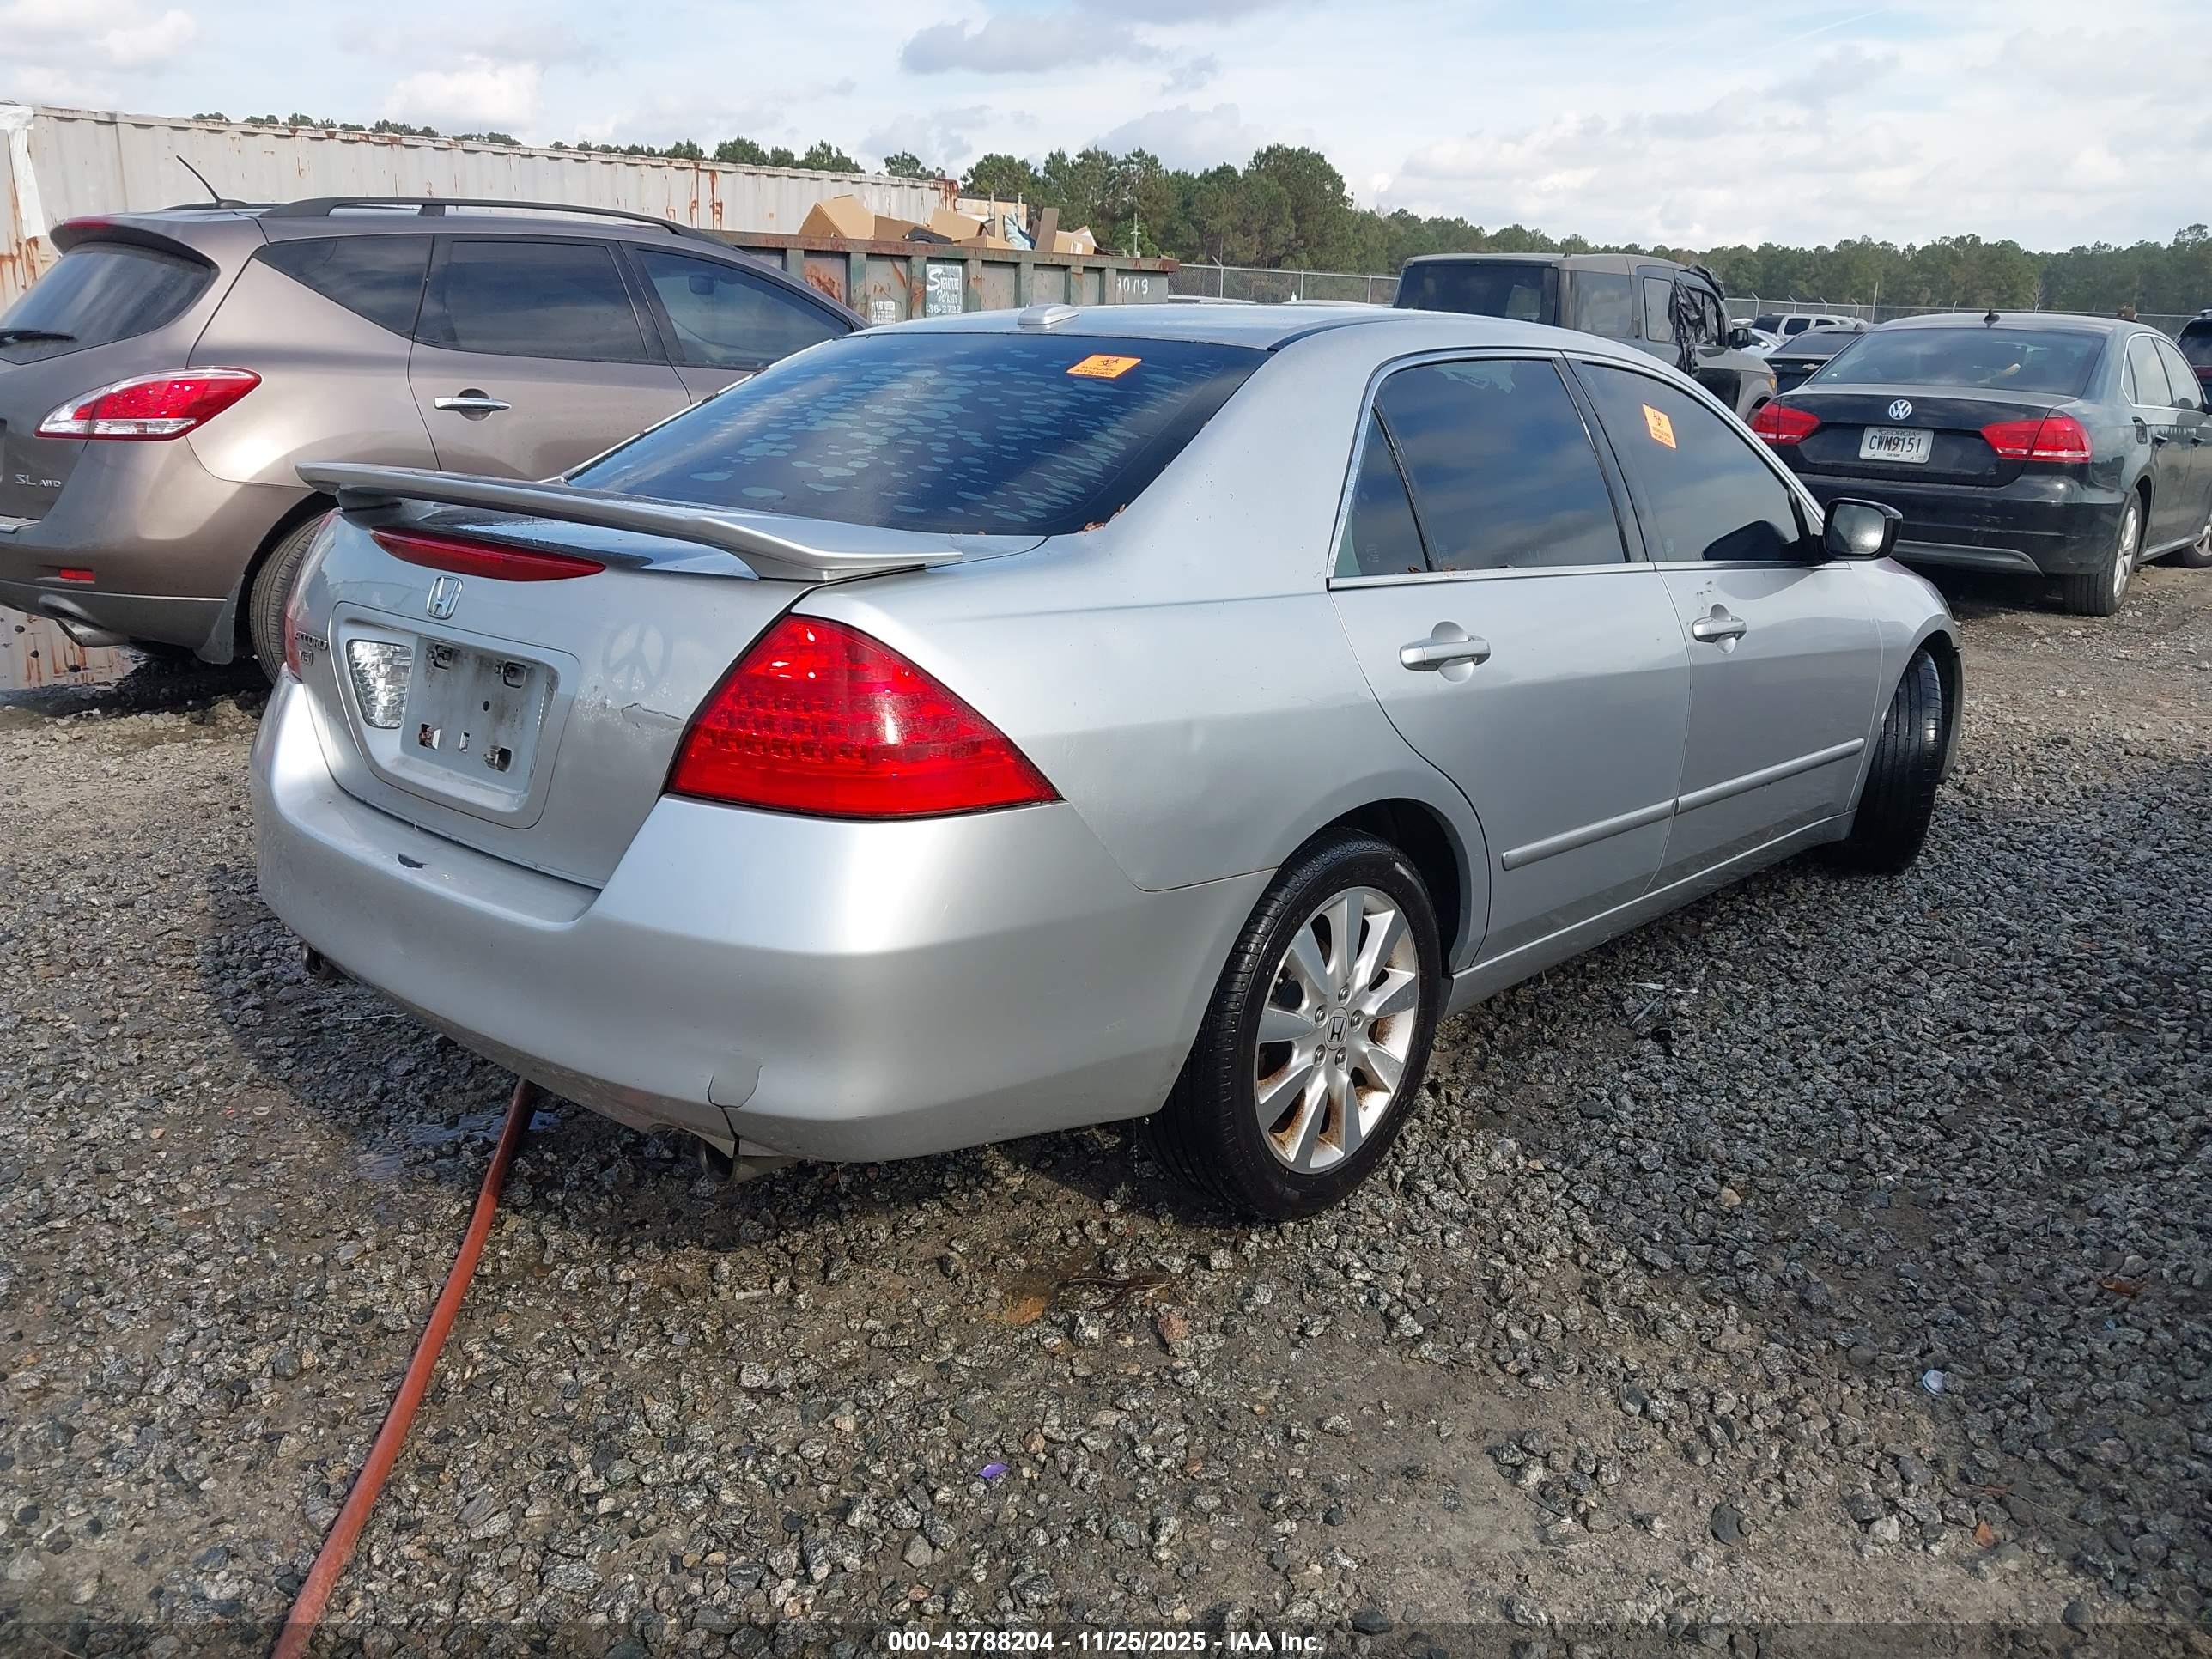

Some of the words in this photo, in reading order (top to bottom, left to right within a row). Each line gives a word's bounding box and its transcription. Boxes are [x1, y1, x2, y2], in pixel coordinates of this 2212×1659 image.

[1869, 435, 1922, 453] CWM9151
[15, 473, 36, 486] SL
[40, 478, 62, 488] AWD
